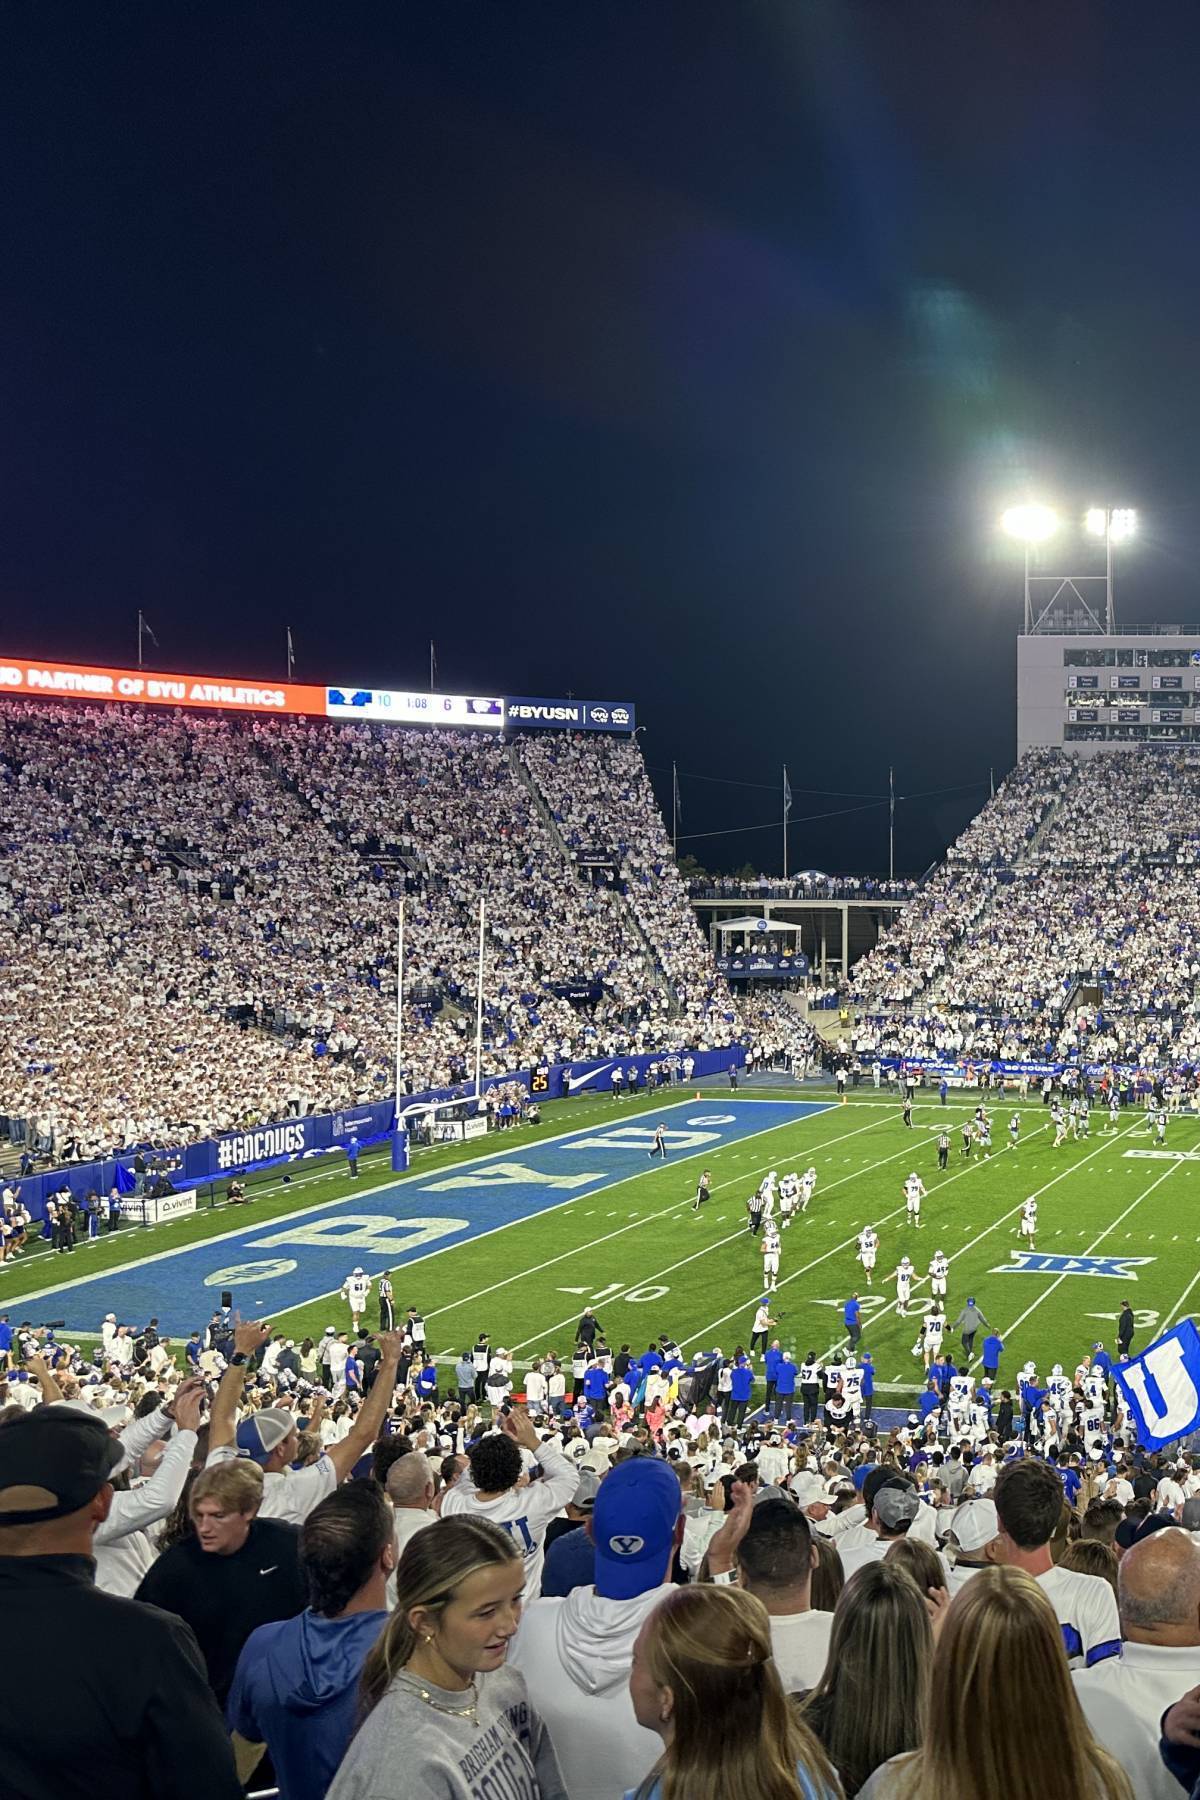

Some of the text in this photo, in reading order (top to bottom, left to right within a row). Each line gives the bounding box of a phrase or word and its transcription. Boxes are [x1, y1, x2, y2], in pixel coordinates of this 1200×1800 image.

[27, 669, 113, 693] PARTNER
[118, 677, 144, 696] OF
[147, 680, 185, 699] BYU
[190, 683, 285, 706] ATHLETICS
[377, 695, 391, 706] 10
[407, 697, 427, 709] 1:08
[443, 699, 452, 711] 6
[508, 705, 578, 721] #BYUSN
[532, 1074, 548, 1091] 25
[218, 1123, 305, 1169] #GOCOUGS
[171, 1196, 192, 1209] vivint
[590, 1282, 670, 1303] 10
[929, 1321, 941, 1333] 70
[846, 1377, 860, 1387] 75
[1089, 1385, 1097, 1397] 4
[1087, 1417, 1100, 1430] 86
[613, 1536, 634, 1553] Y
[458, 1725, 504, 1784] BRIGHAM
